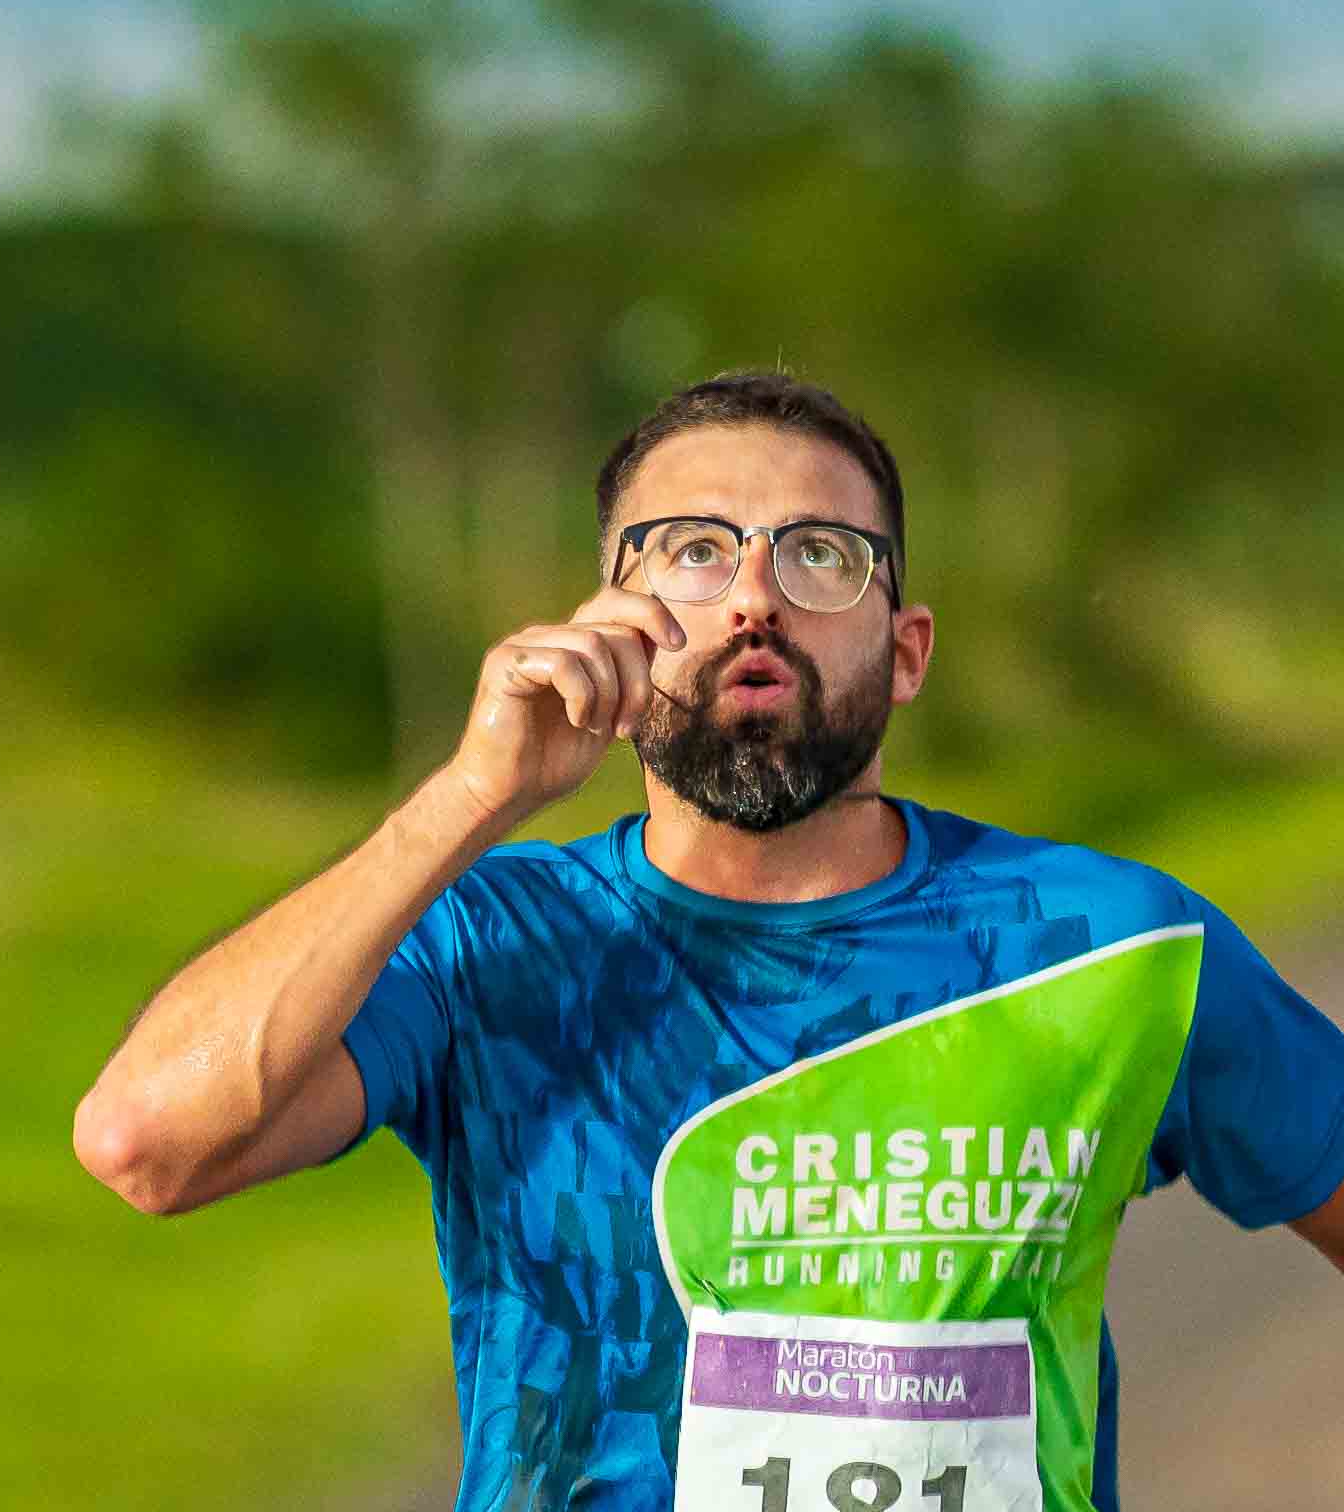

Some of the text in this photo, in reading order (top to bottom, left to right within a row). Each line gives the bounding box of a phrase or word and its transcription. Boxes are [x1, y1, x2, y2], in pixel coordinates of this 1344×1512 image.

[735, 1126, 1102, 1183] CRISTIAN
[727, 1248, 955, 1287] RUNNING
[777, 1339, 895, 1372] Maratón
[773, 1368, 968, 1403] NOCTURNA
